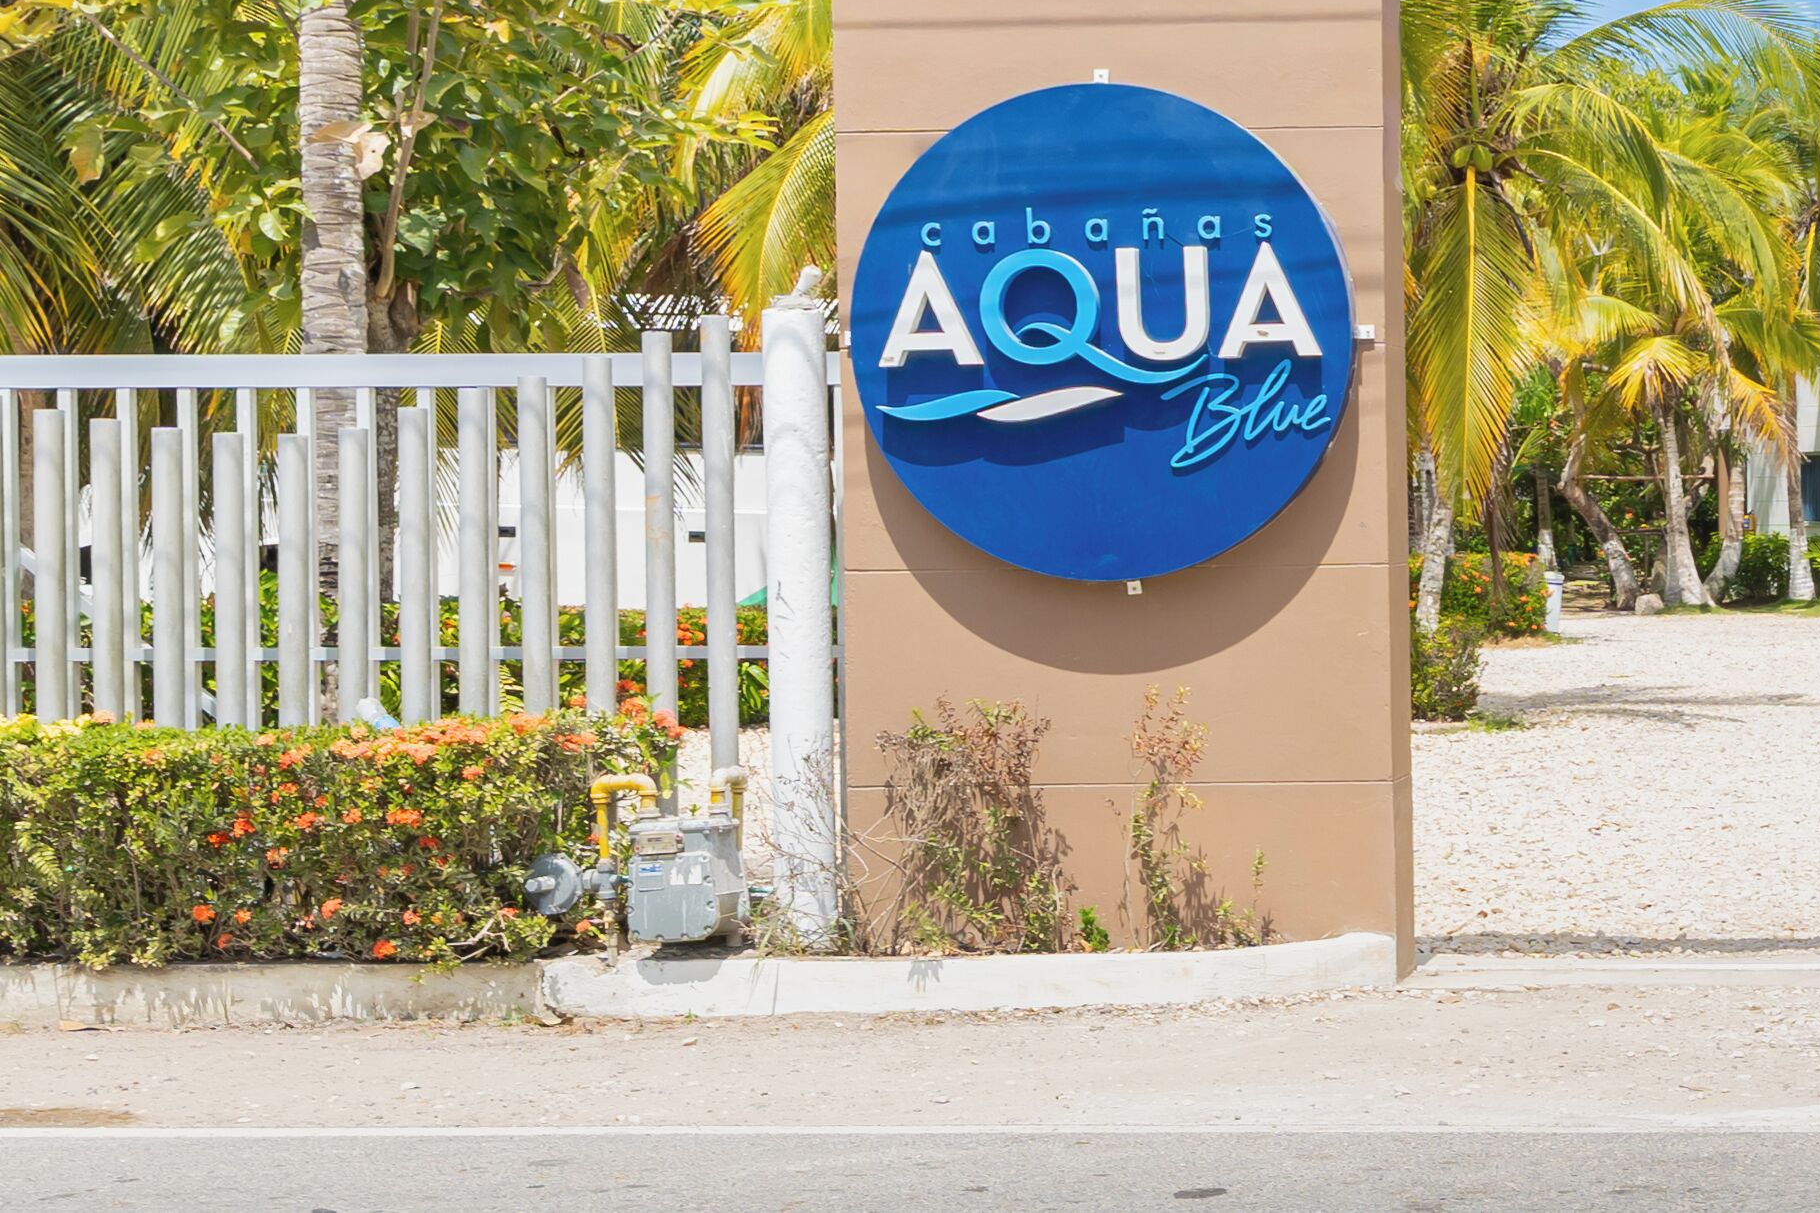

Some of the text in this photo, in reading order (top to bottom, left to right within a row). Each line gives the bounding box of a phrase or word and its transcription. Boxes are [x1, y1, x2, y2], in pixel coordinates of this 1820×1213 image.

[920, 207, 1272, 246] cabañas
[878, 241, 1323, 384] AQUA
[1161, 359, 1331, 468] Blue
